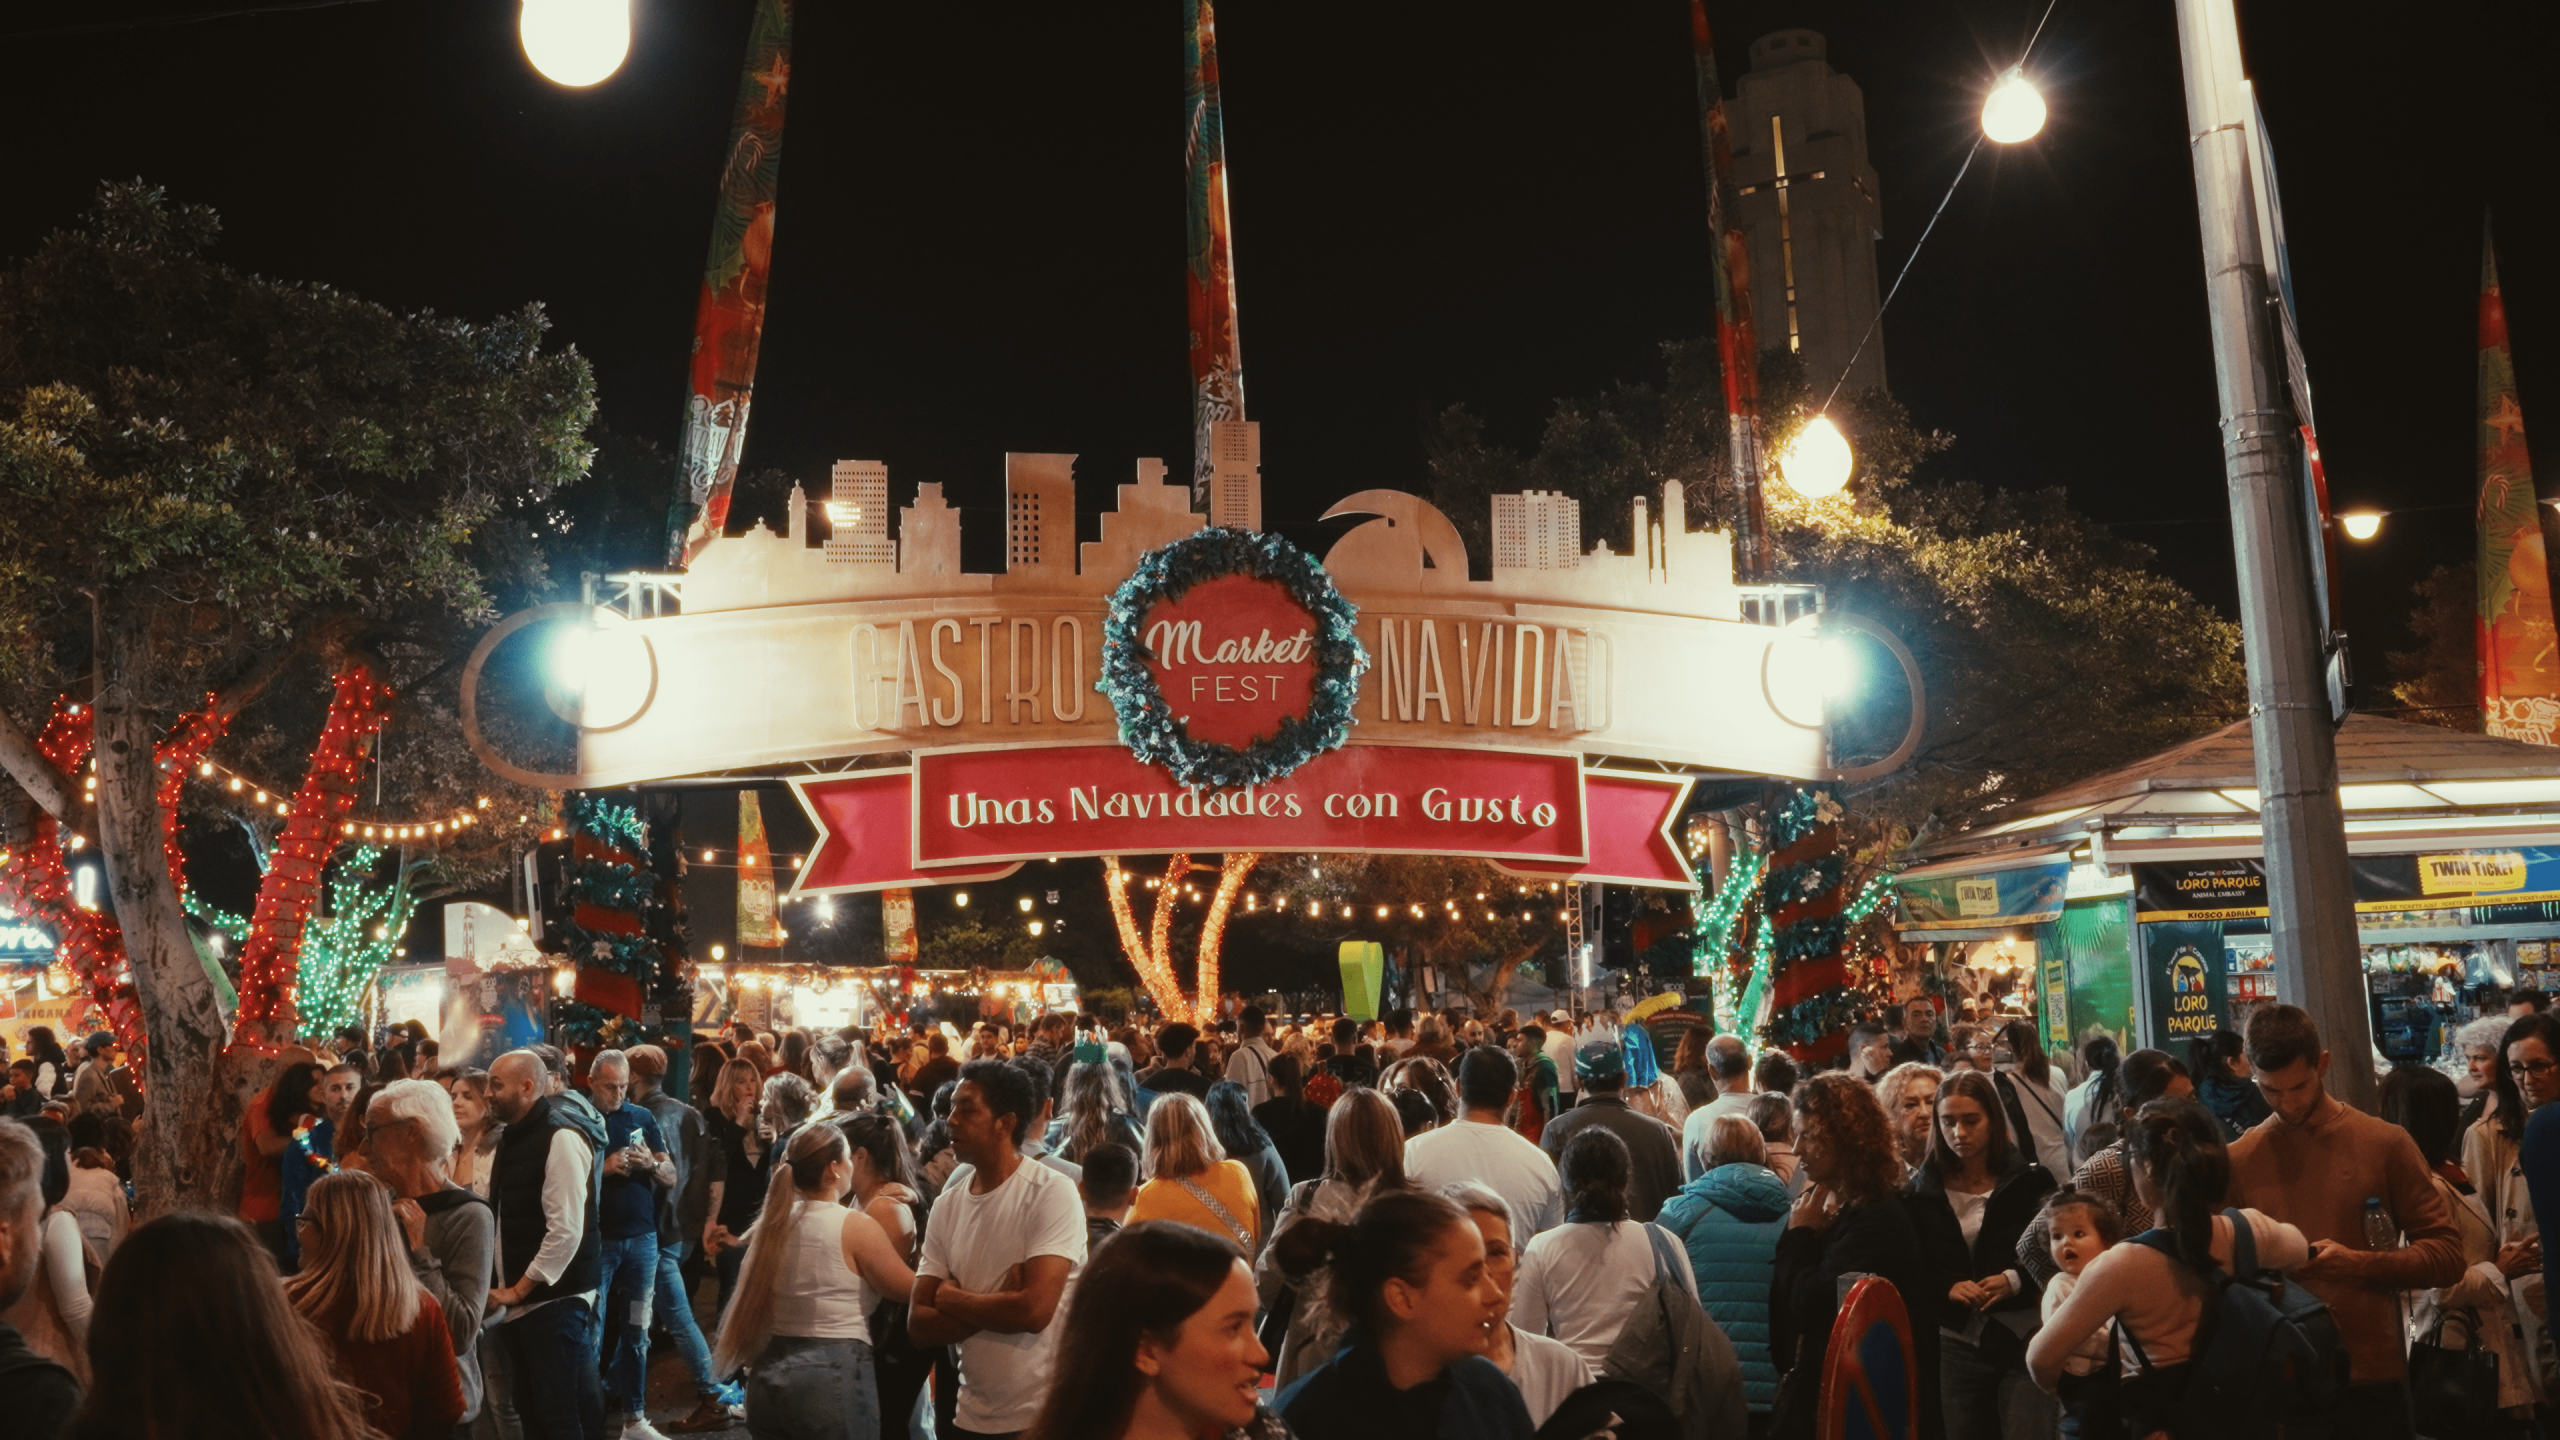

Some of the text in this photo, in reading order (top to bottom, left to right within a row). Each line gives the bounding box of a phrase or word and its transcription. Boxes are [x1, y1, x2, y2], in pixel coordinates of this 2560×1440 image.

[1145, 620, 1314, 670] Market
[849, 615, 1613, 732] GASTRO NAVIDAD
[1191, 675, 1284, 702] FEST
[949, 784, 1557, 828] Unas Navidades con Gusto
[2430, 860, 2514, 877] TWIN TICKET
[2176, 876, 2261, 890] LORO PARQUE
[2192, 890, 2246, 899] ANIMAL EMBASSY
[2187, 911, 2223, 919] KIOSCO
[2174, 995, 2208, 1012] LORO
[2168, 1014, 2217, 1034] PARQUE
